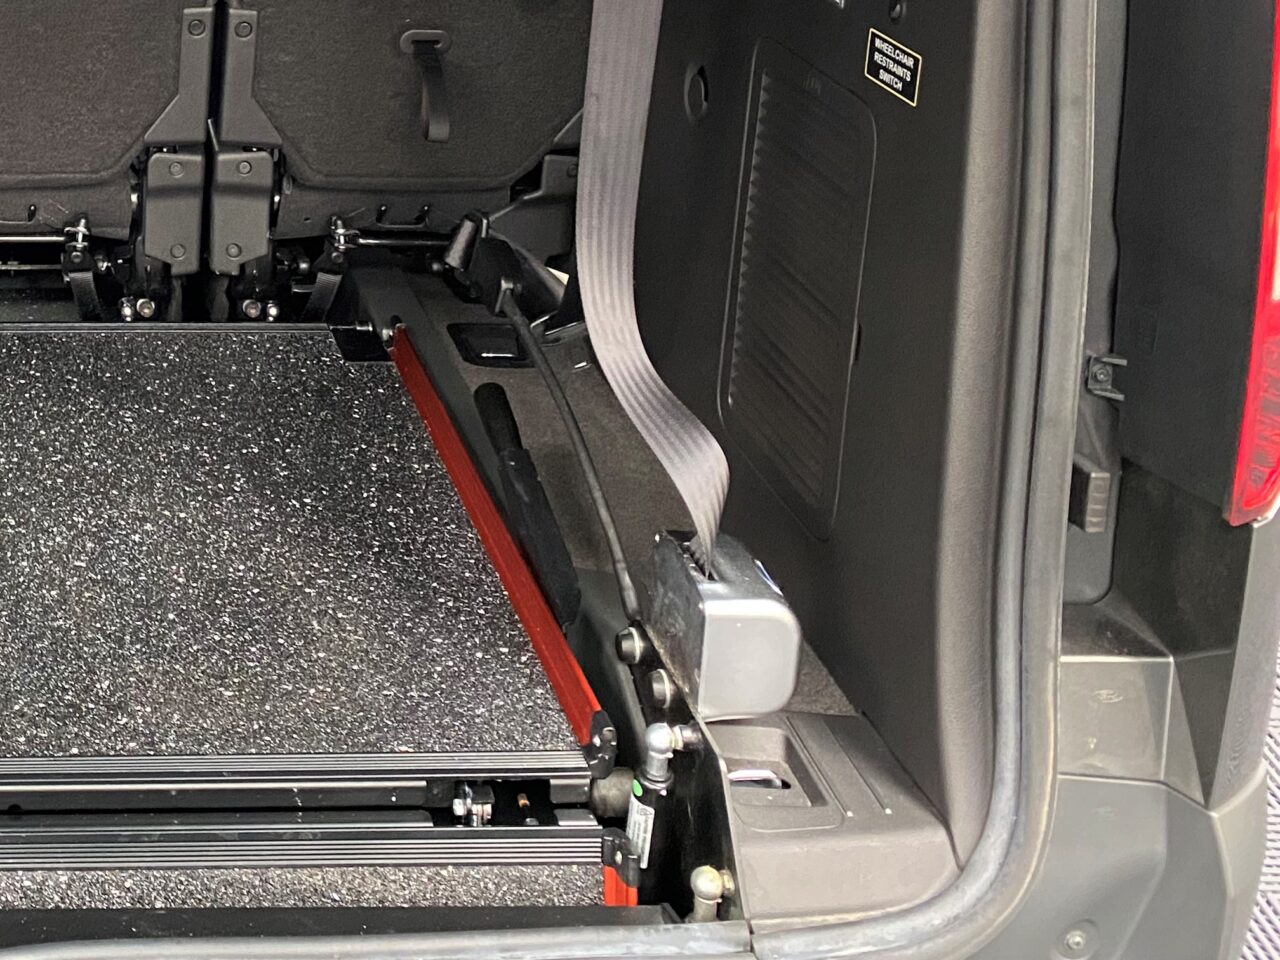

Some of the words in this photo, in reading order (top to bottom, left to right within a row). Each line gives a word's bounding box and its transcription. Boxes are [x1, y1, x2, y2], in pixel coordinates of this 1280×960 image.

[873, 51, 912, 82] RESTRAINTS
[874, 37, 914, 69] WHEELCHAIR
[879, 69, 903, 91] SWITCH
